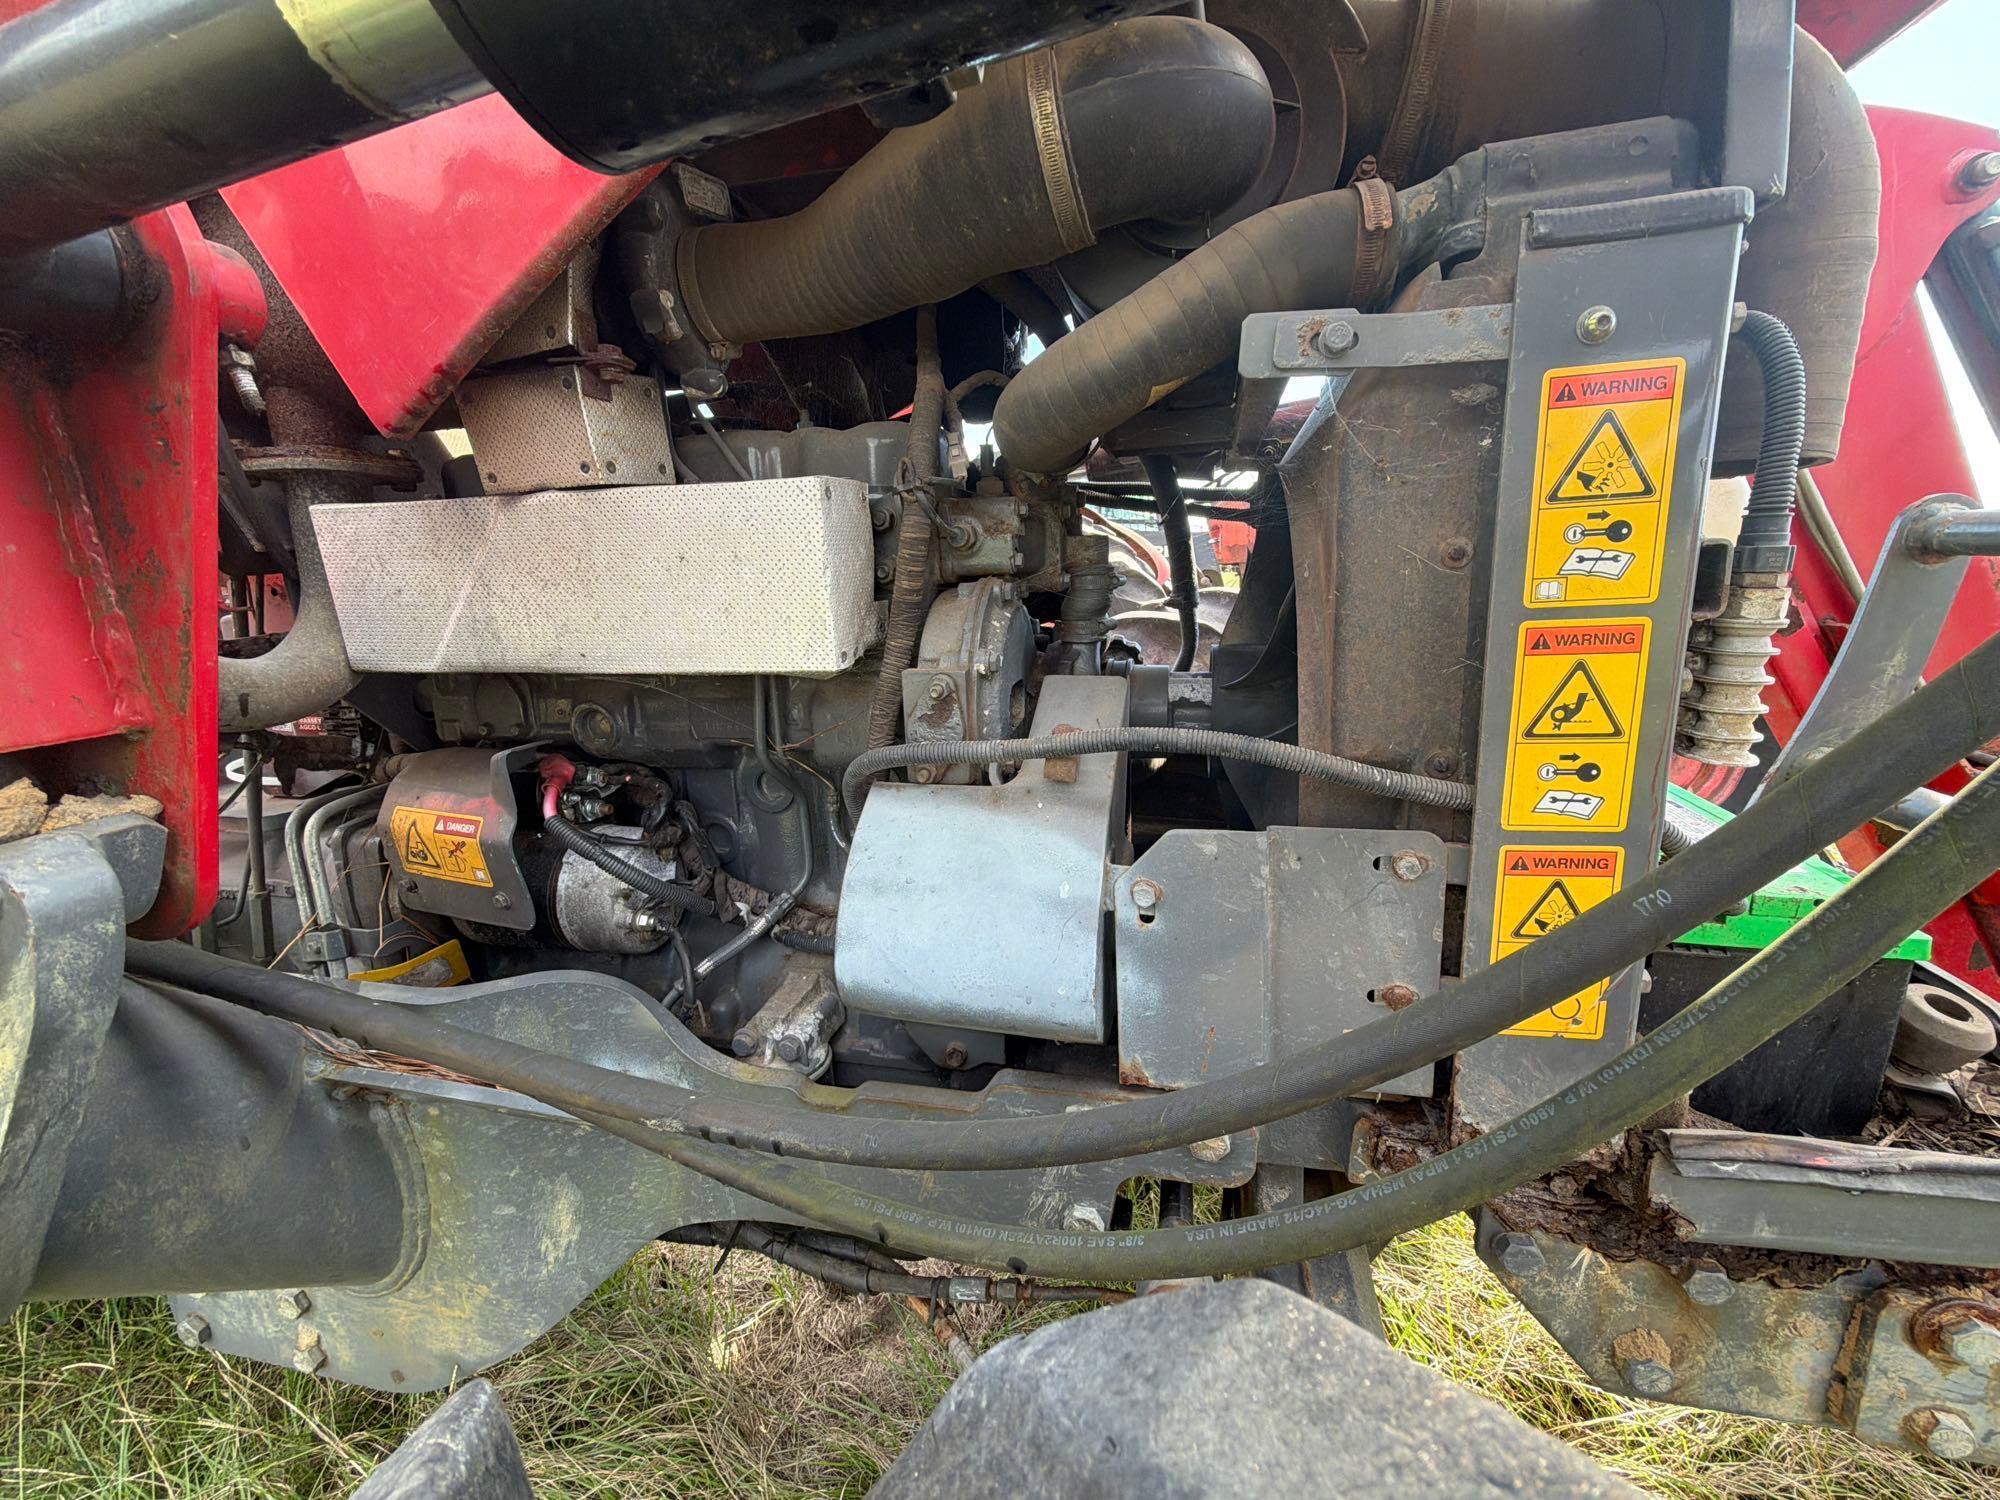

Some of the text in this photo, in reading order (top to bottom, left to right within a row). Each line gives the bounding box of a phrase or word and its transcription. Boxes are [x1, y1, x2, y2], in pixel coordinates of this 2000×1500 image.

[1581, 375, 1667, 397] WARNING
[1555, 631, 1635, 647] WARNING
[446, 820, 476, 834] DANGER
[1533, 857, 1609, 870] WARNING
[1518, 1103, 1557, 1131] 4800
[1490, 1127, 1519, 1150] PSI
[1359, 1177, 1408, 1201] MSHA
[873, 1203, 894, 1217] PSI
[895, 1209, 921, 1224] 4800
[955, 1223, 996, 1239] (DN10)
[1219, 1226, 1234, 1238] IN
[1235, 1215, 1281, 1235] MADE
[999, 1230, 1084, 1247] 100R2AT/2SN
[1086, 1235, 1116, 1248] SAE
[1117, 1235, 1145, 1247] 3/8"
[1184, 1228, 1216, 1243] USA
